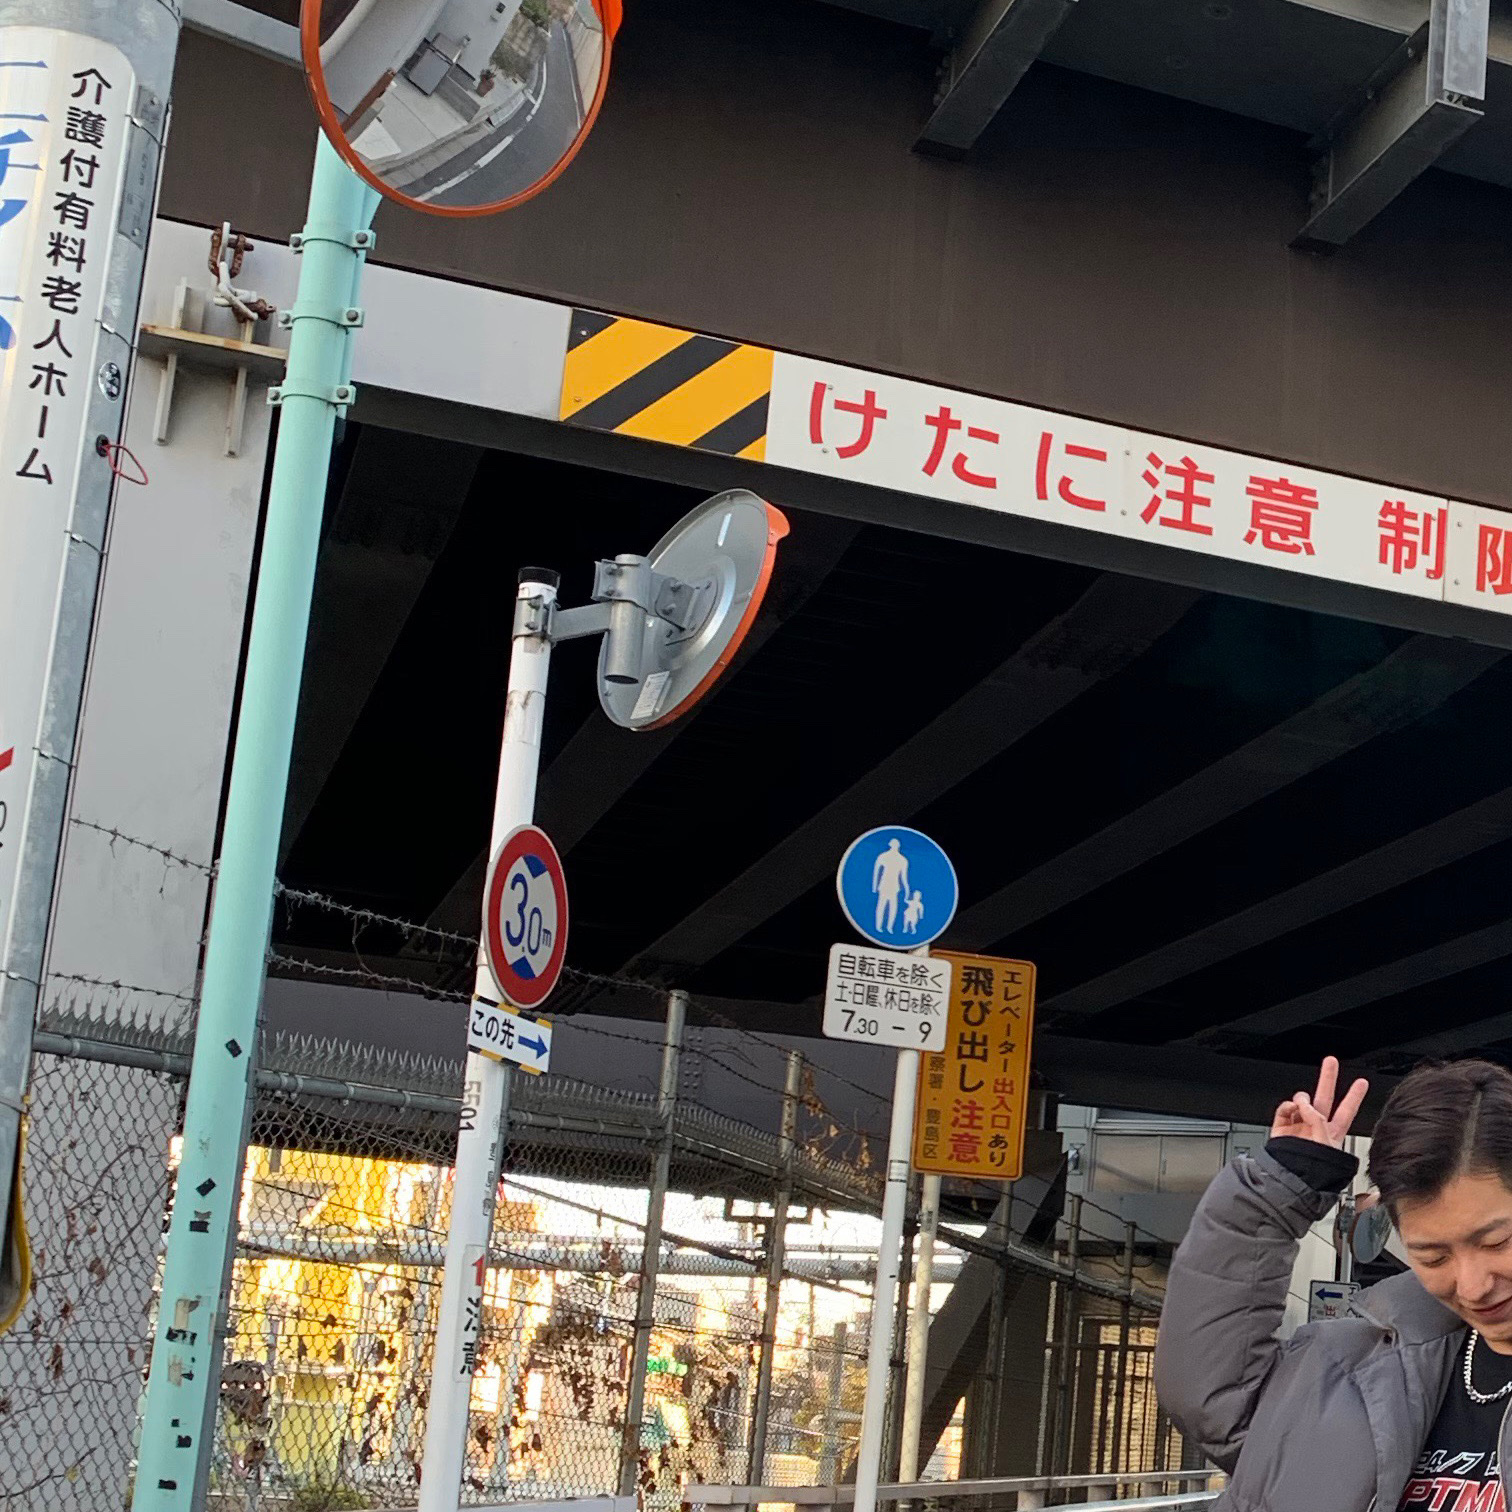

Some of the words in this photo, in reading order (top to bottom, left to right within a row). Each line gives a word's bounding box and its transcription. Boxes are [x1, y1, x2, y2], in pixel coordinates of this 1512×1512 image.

[16, 67, 112, 486] 介護付有料老人ホーム
[809, 381, 1319, 556] けたに注意
[838, 953, 943, 989] 自転車を除く
[471, 1009, 515, 1050] この先
[918, 1021, 932, 1044] 9
[947, 965, 994, 1165] 飛び出し注意
